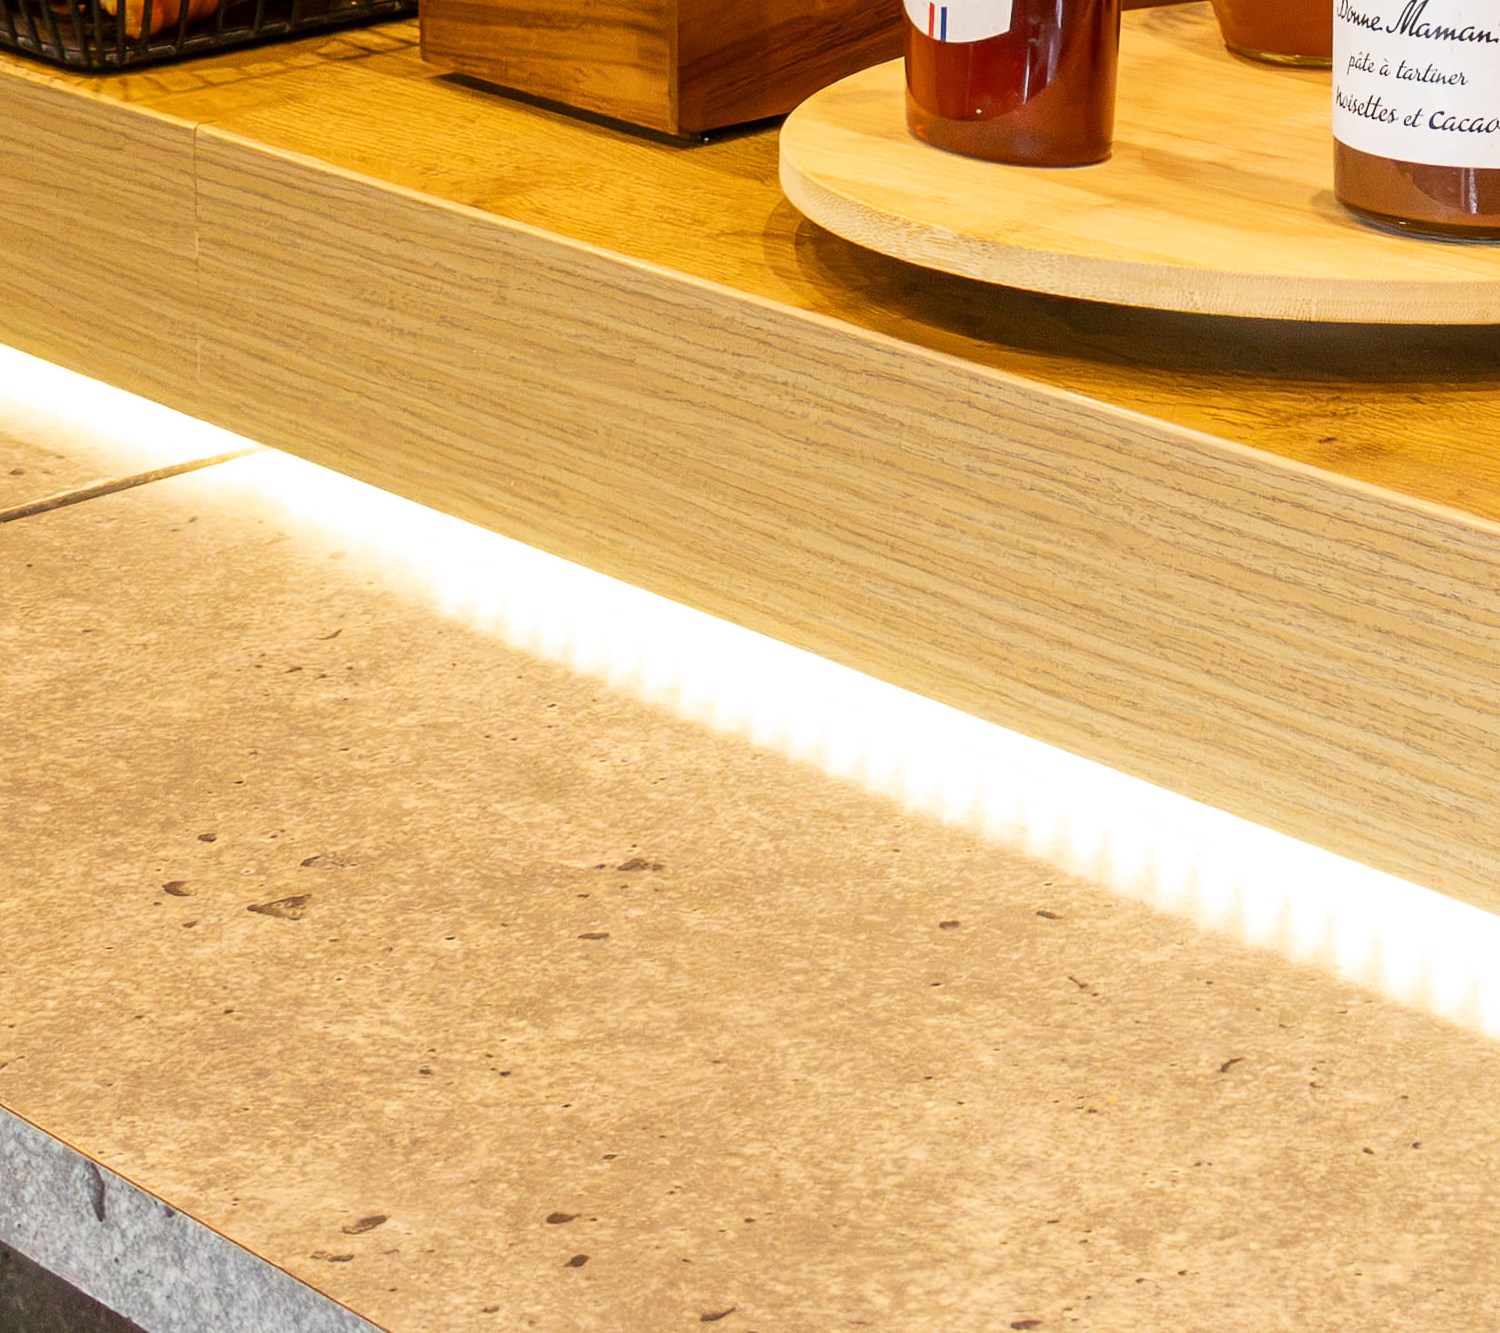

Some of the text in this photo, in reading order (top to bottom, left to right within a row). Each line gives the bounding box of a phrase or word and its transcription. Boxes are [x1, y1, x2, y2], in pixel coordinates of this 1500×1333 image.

[1347, 51, 1468, 86] pâte à tartiner
[1335, 85, 1398, 124] noisettes
[1403, 108, 1424, 128] et
